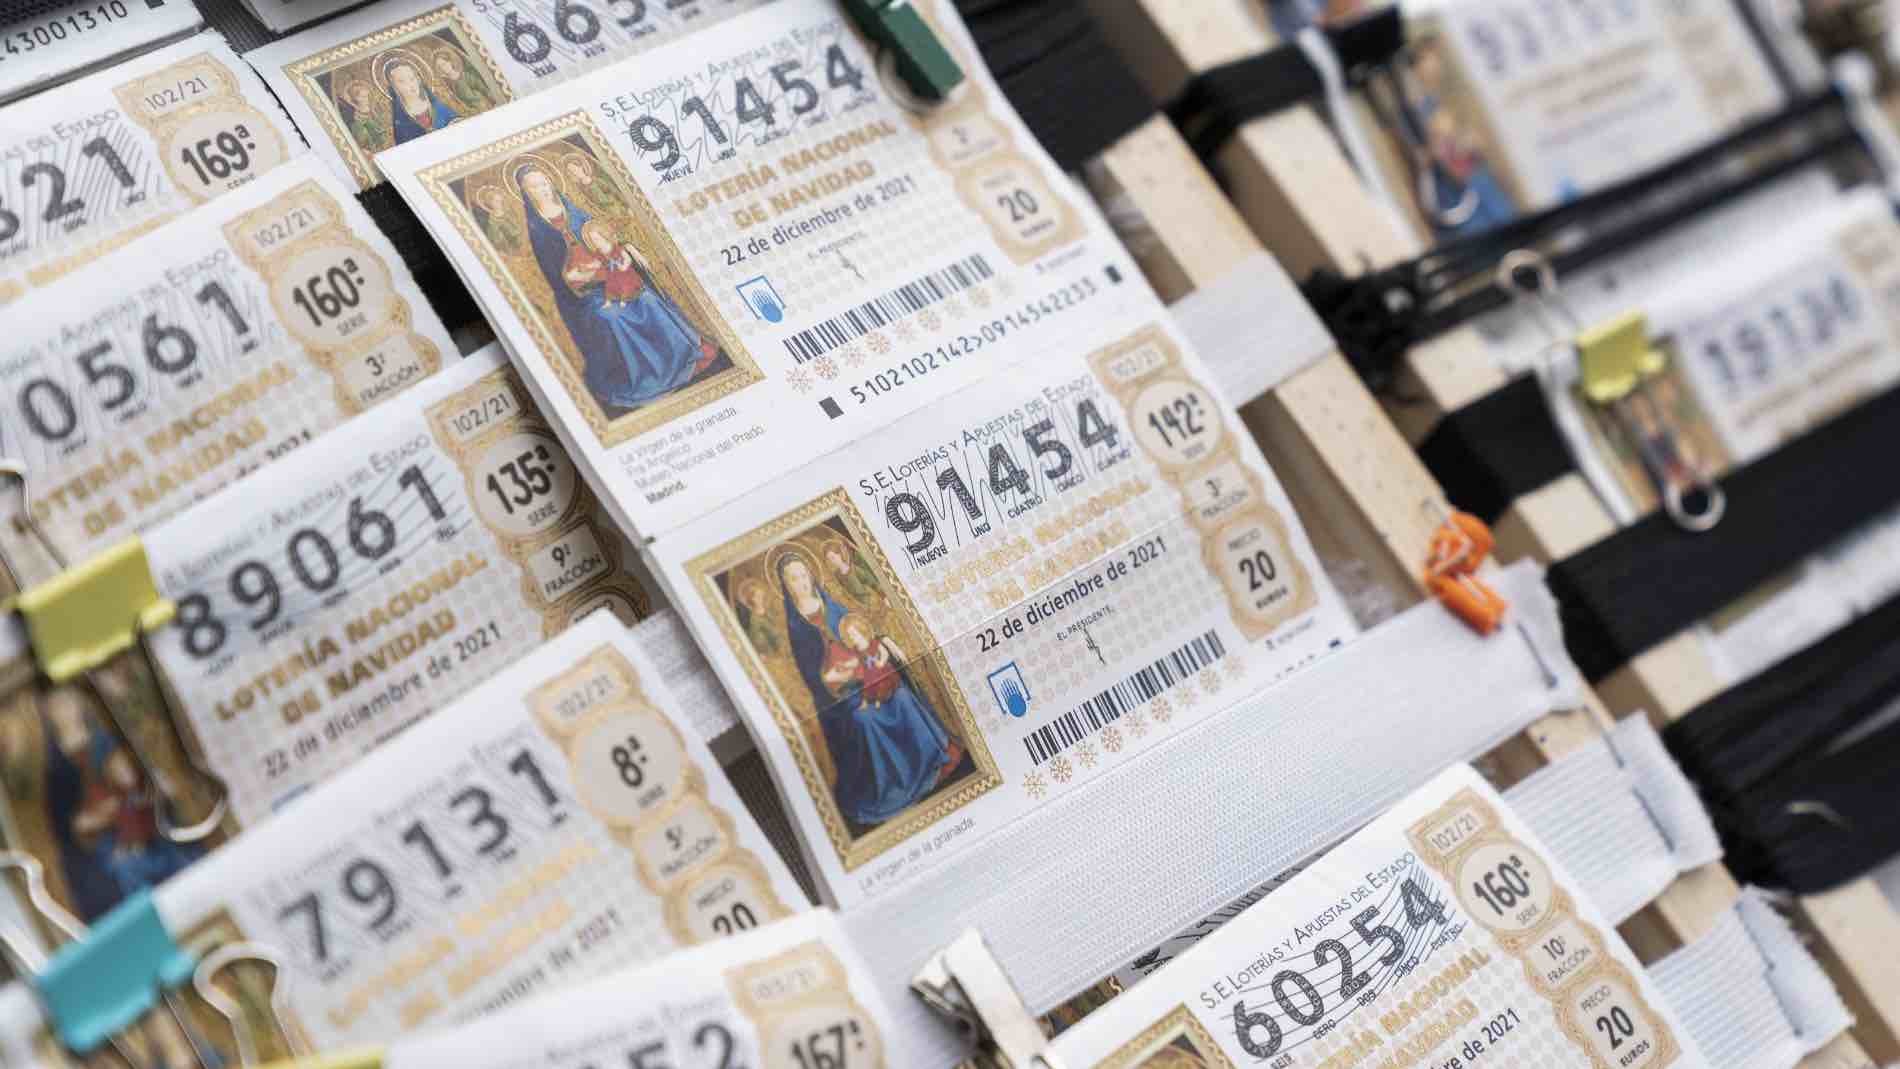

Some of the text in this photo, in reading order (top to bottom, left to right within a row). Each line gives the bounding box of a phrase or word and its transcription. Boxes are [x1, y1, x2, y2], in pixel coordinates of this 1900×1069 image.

[0, 0, 128, 60] 43001310
[145, 77, 209, 111] 102/21
[629, 43, 863, 172] 91454
[672, 162, 777, 218] LOTERÍA
[780, 119, 897, 175] NACIONAL
[733, 160, 876, 231] DE NAVIDAD
[253, 206, 318, 249] 102/21
[720, 245, 748, 266] 22
[747, 232, 770, 256] de
[771, 202, 853, 246] diciembre
[853, 190, 878, 211] de
[876, 172, 917, 201] 2021
[997, 187, 1039, 223] 20
[452, 393, 512, 435] 102/21
[888, 446, 949, 481] LOTERÍAS
[949, 439, 959, 452] Y
[961, 409, 1025, 448] APUESTAS
[885, 398, 1118, 553] 91454
[526, 502, 559, 528] SERIE
[972, 521, 992, 539] UNO
[1006, 494, 1044, 520] CUATRO
[174, 464, 447, 661] 89061
[975, 534, 1167, 652] 22 de diciembre de 2021
[1238, 550, 1277, 593] 20
[214, 552, 490, 722] LOTERÍA NACIONAL
[279, 608, 458, 726] DE NAVIDAD
[322, 671, 424, 742] diciembre
[425, 654, 452, 680] de
[451, 619, 503, 663] 2021
[277, 748, 560, 963] 79131
[1431, 811, 1480, 851] 102/21
[1227, 945, 1286, 994] LOTERÍAS
[1281, 937, 1294, 952] Y
[1294, 897, 1353, 945] APUESTAS
[1352, 885, 1374, 903] DEL
[1366, 851, 1417, 890] ESTADO
[1233, 878, 1447, 1059] 60254
[1547, 944, 1592, 986] FRACCIÓN
[1579, 983, 1614, 1013] PRECIO
[1596, 1004, 1636, 1050] 20
[1461, 1037, 1487, 1061] de
[1480, 1006, 1522, 1045] 2021
[1619, 1037, 1652, 1068] EUROS
